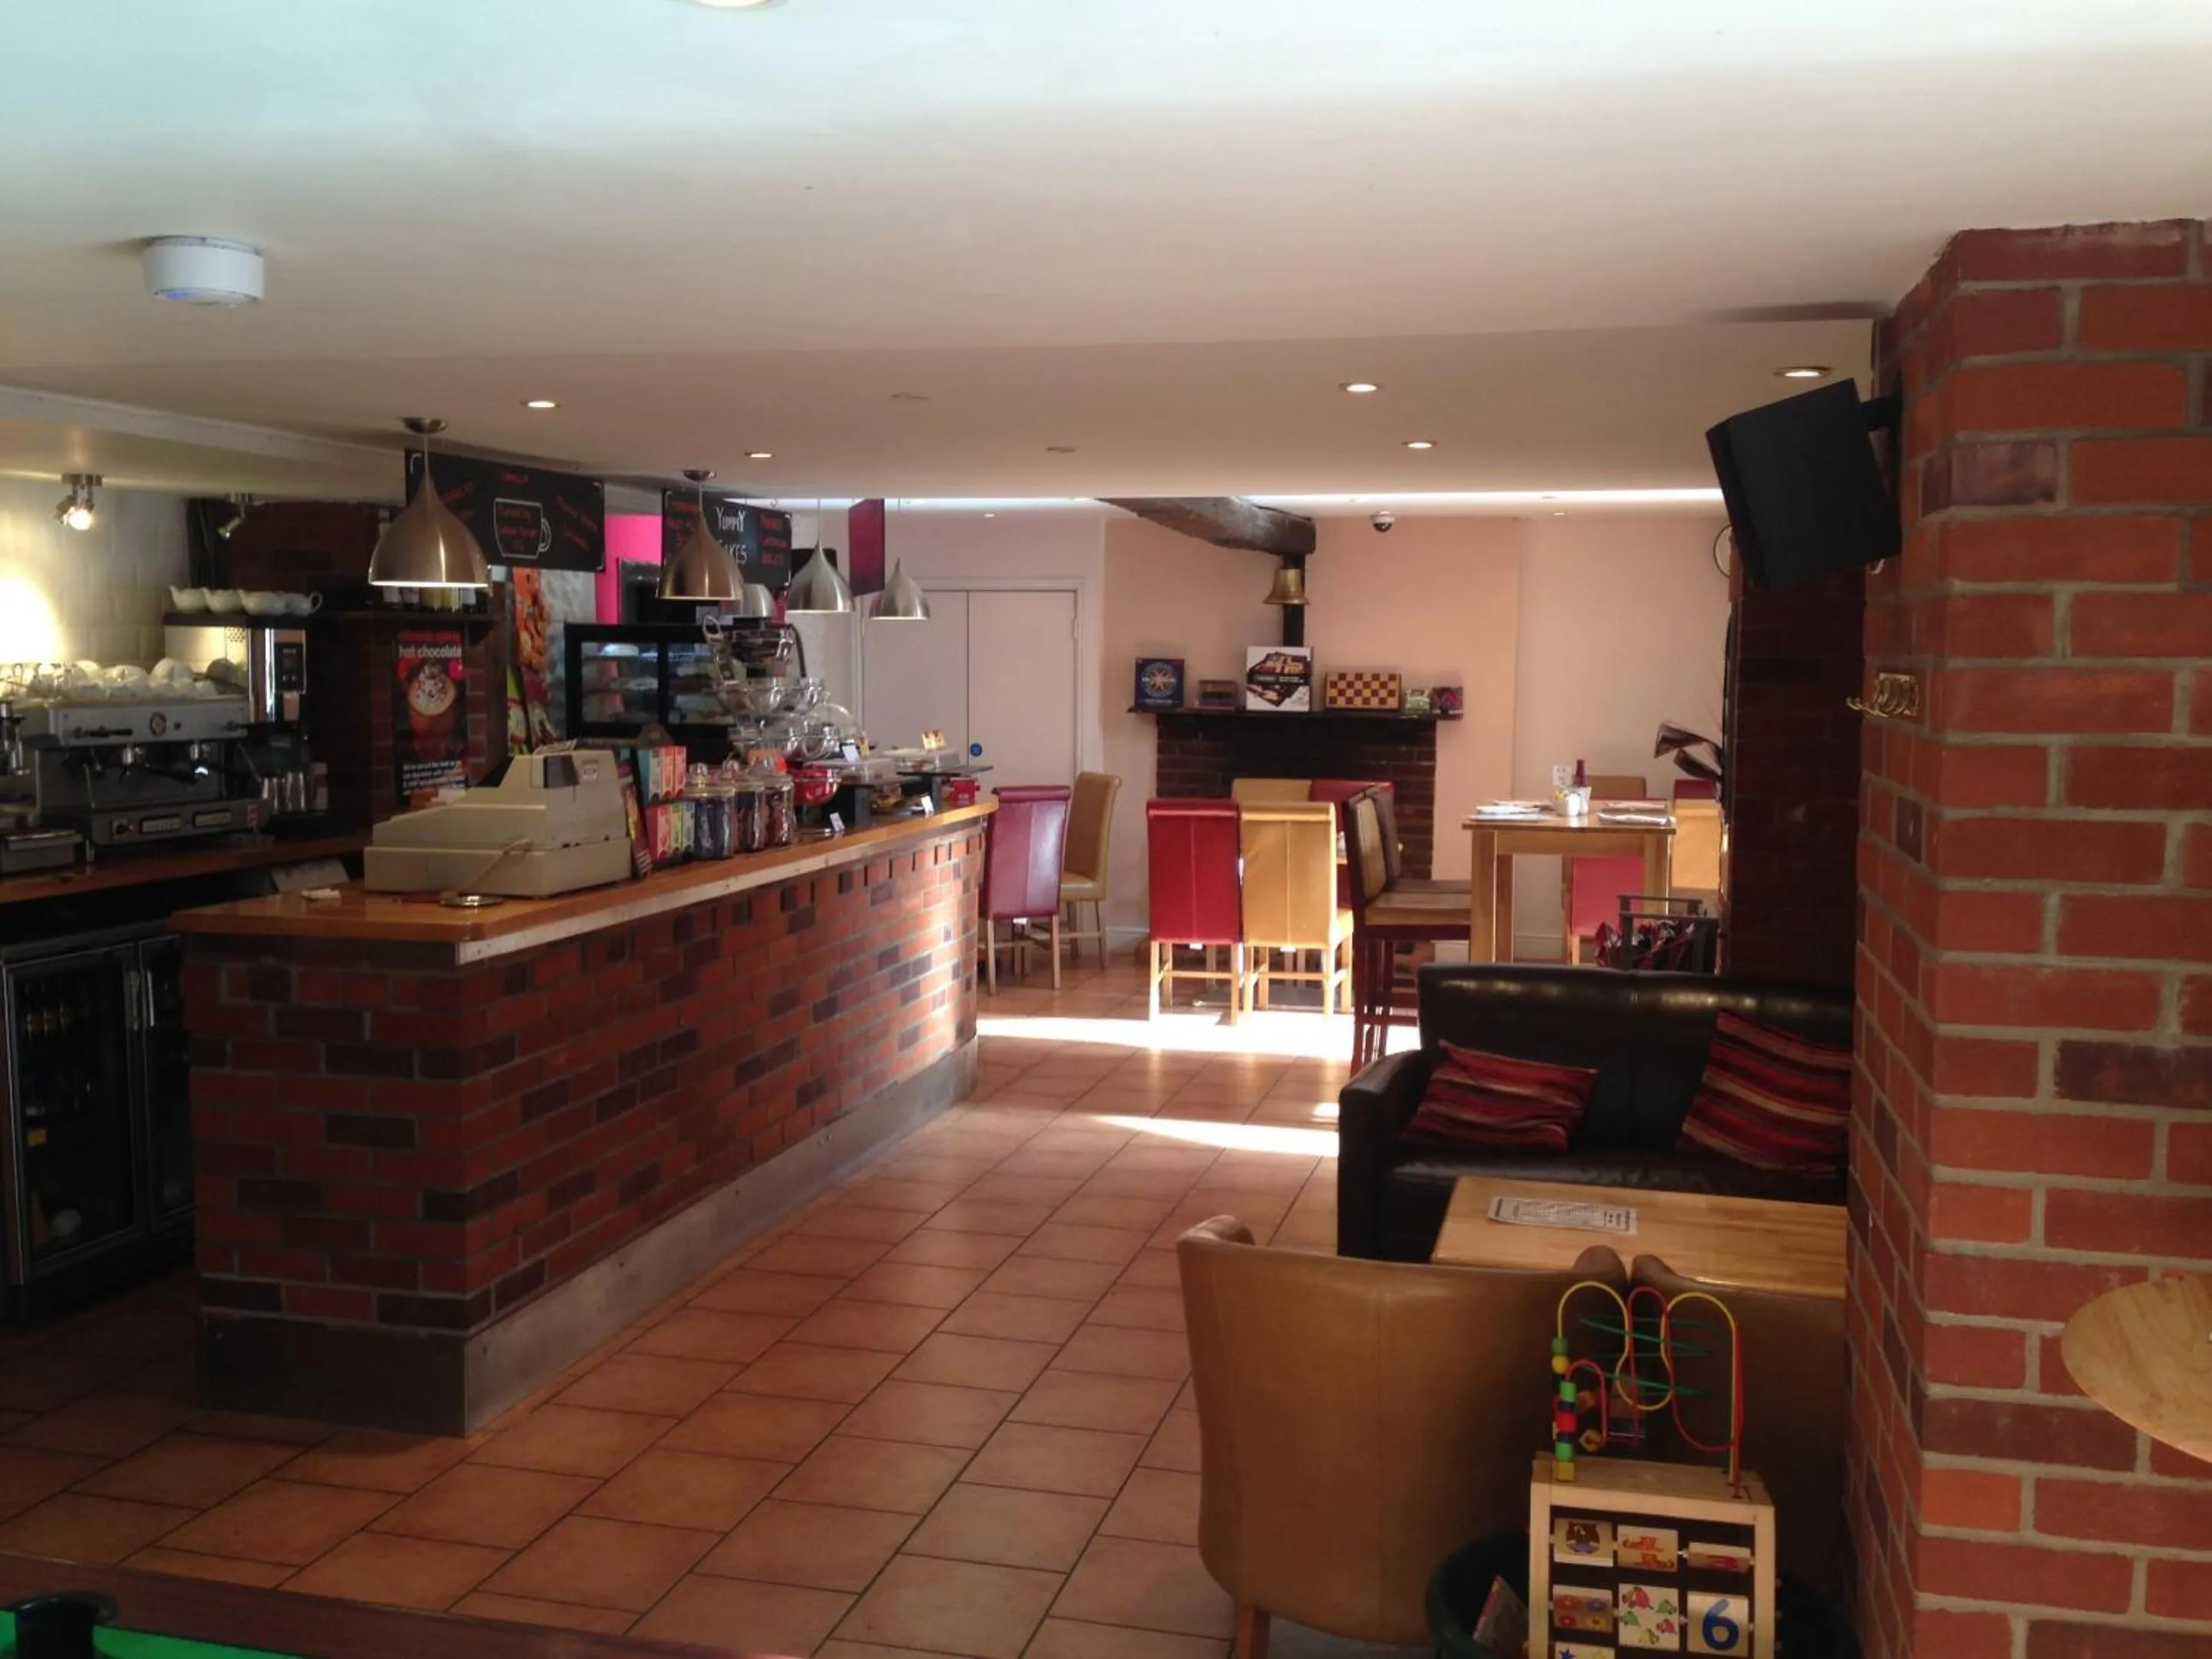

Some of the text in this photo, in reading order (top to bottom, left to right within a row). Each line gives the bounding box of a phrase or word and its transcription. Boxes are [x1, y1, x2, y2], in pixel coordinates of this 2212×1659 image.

[398, 644, 462, 659] hot chocolate
[1702, 1599, 1739, 1651] 6
